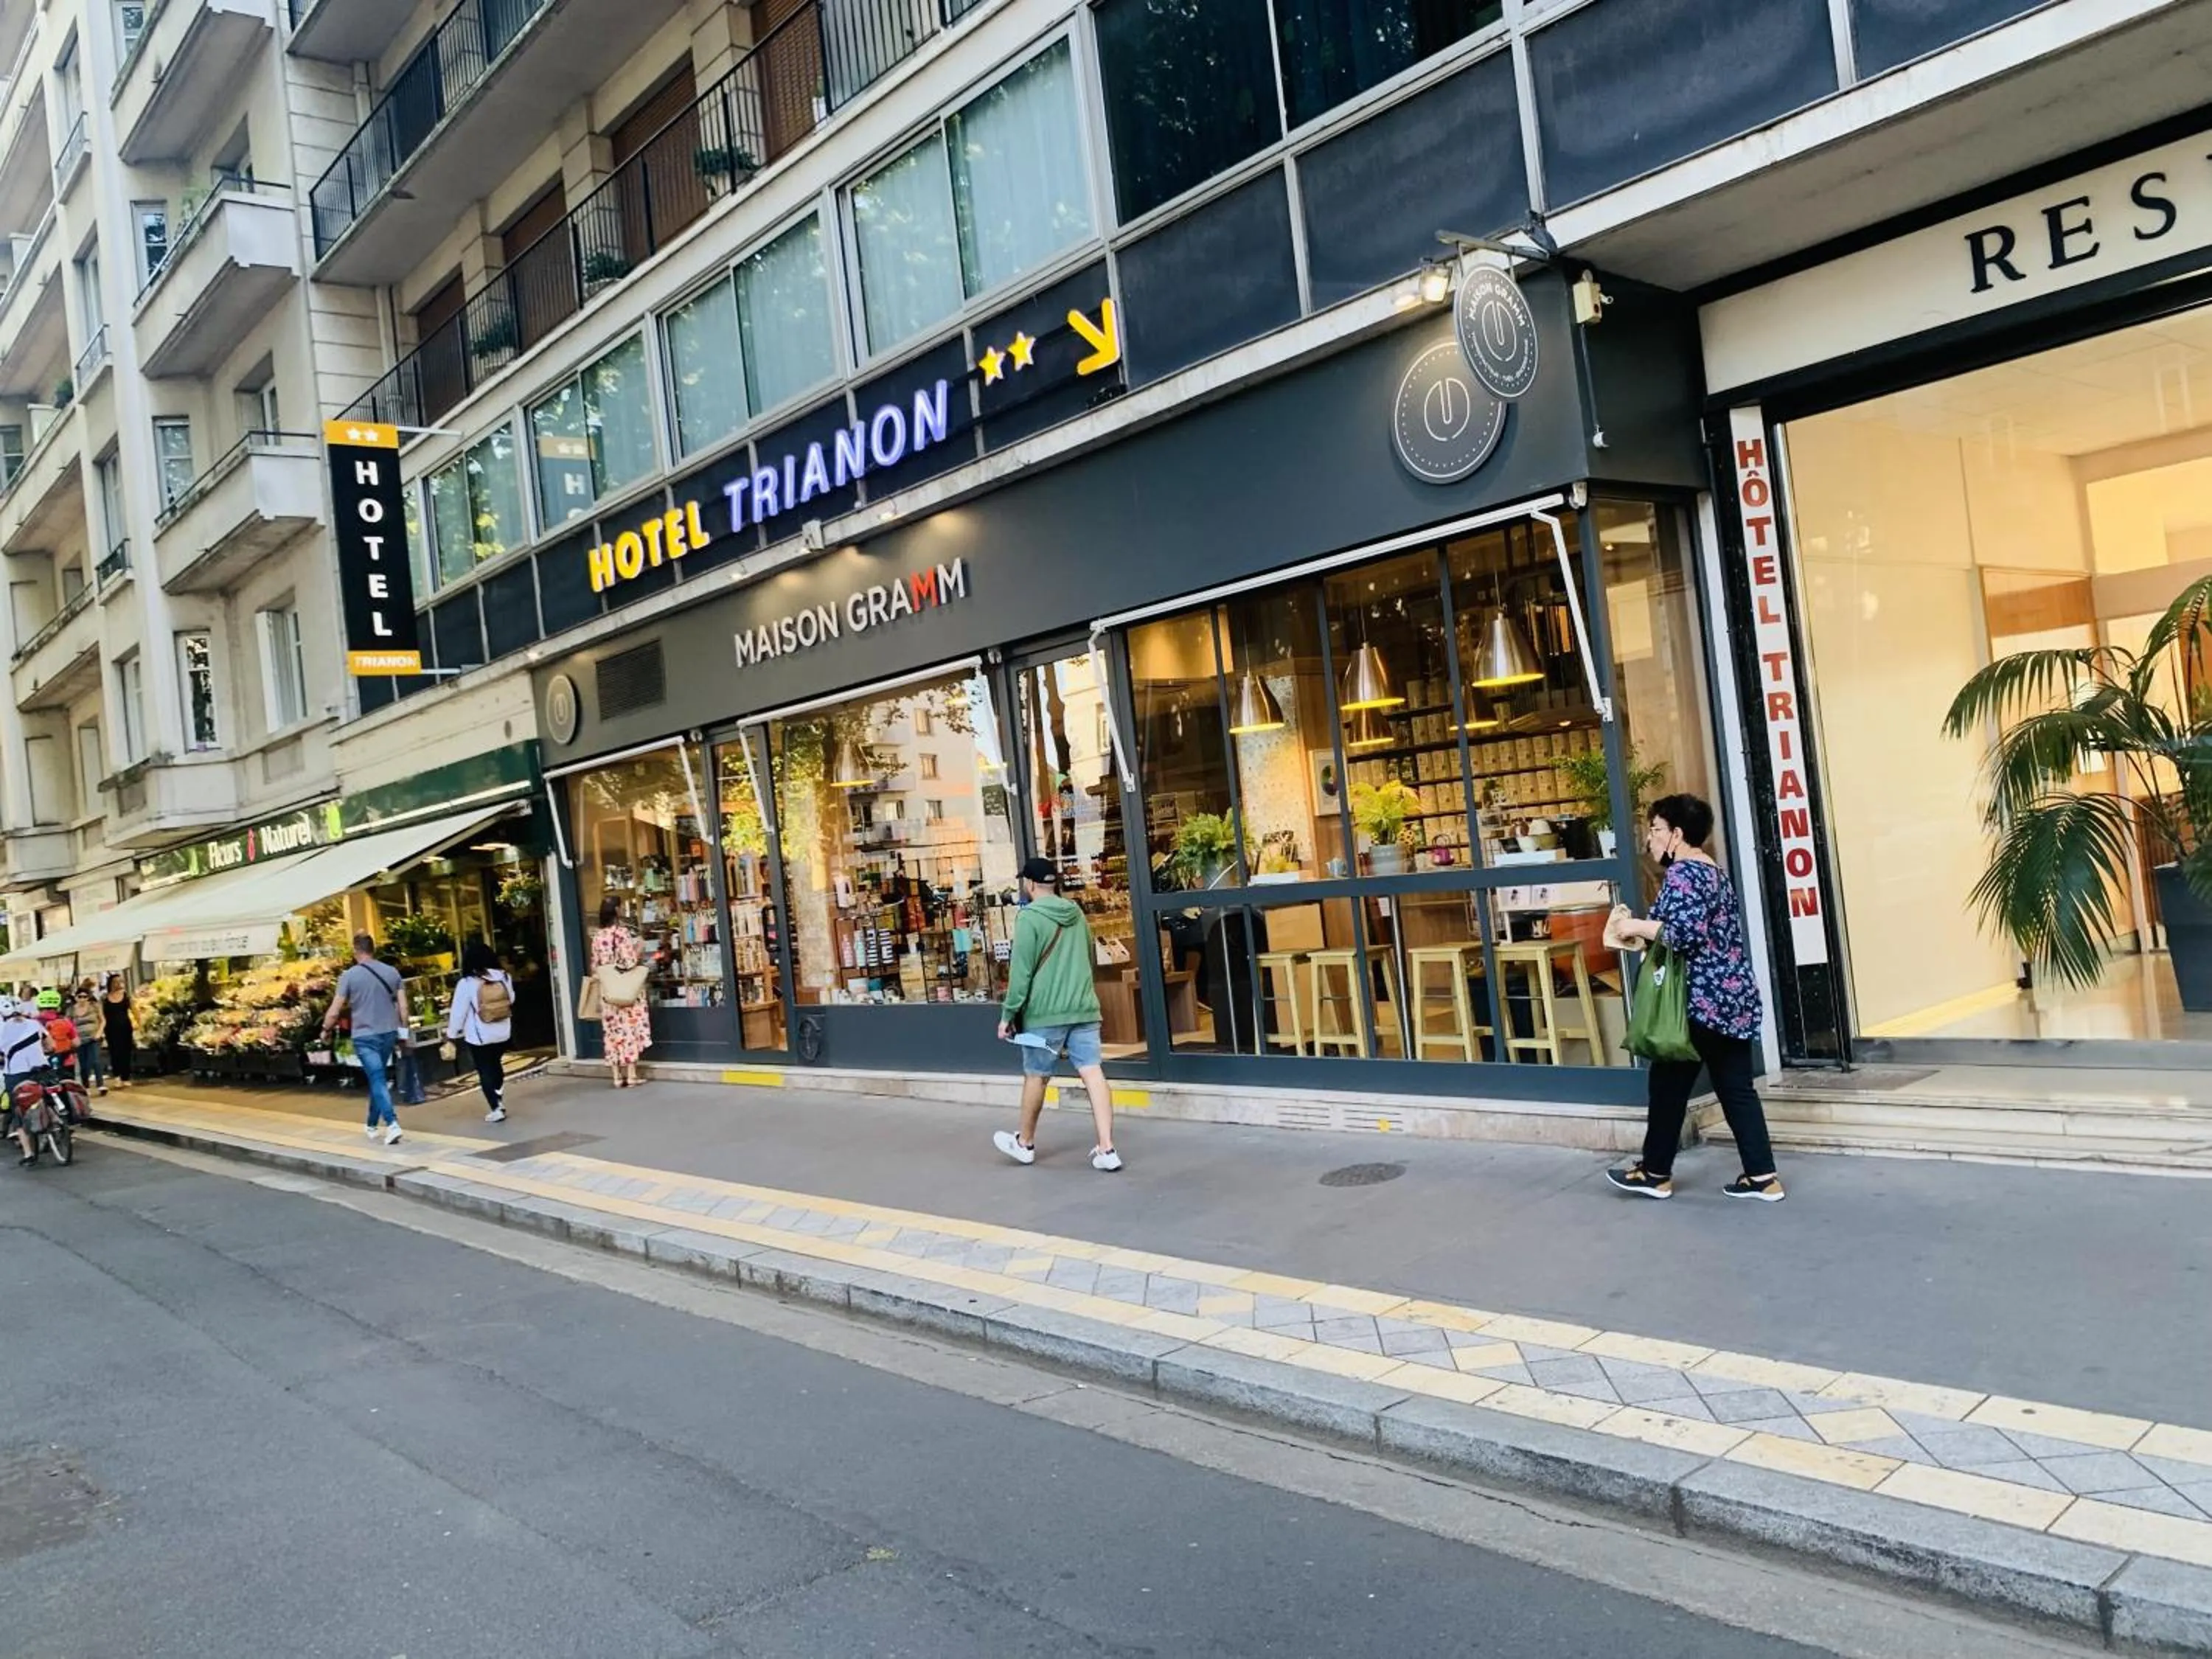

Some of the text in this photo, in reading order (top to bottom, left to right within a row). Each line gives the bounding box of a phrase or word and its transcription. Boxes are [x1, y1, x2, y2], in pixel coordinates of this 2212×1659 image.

[1964, 153, 2212, 293] RES
[1469, 282, 1526, 327] MAISON GRAMM
[354, 460, 393, 636] HOTEL
[588, 378, 950, 593] HOTEL TRIANON
[355, 655, 417, 669] TRIANON
[733, 557, 967, 667] MAISON GRAMM
[1736, 438, 1820, 918] HÔTEL TRIANON
